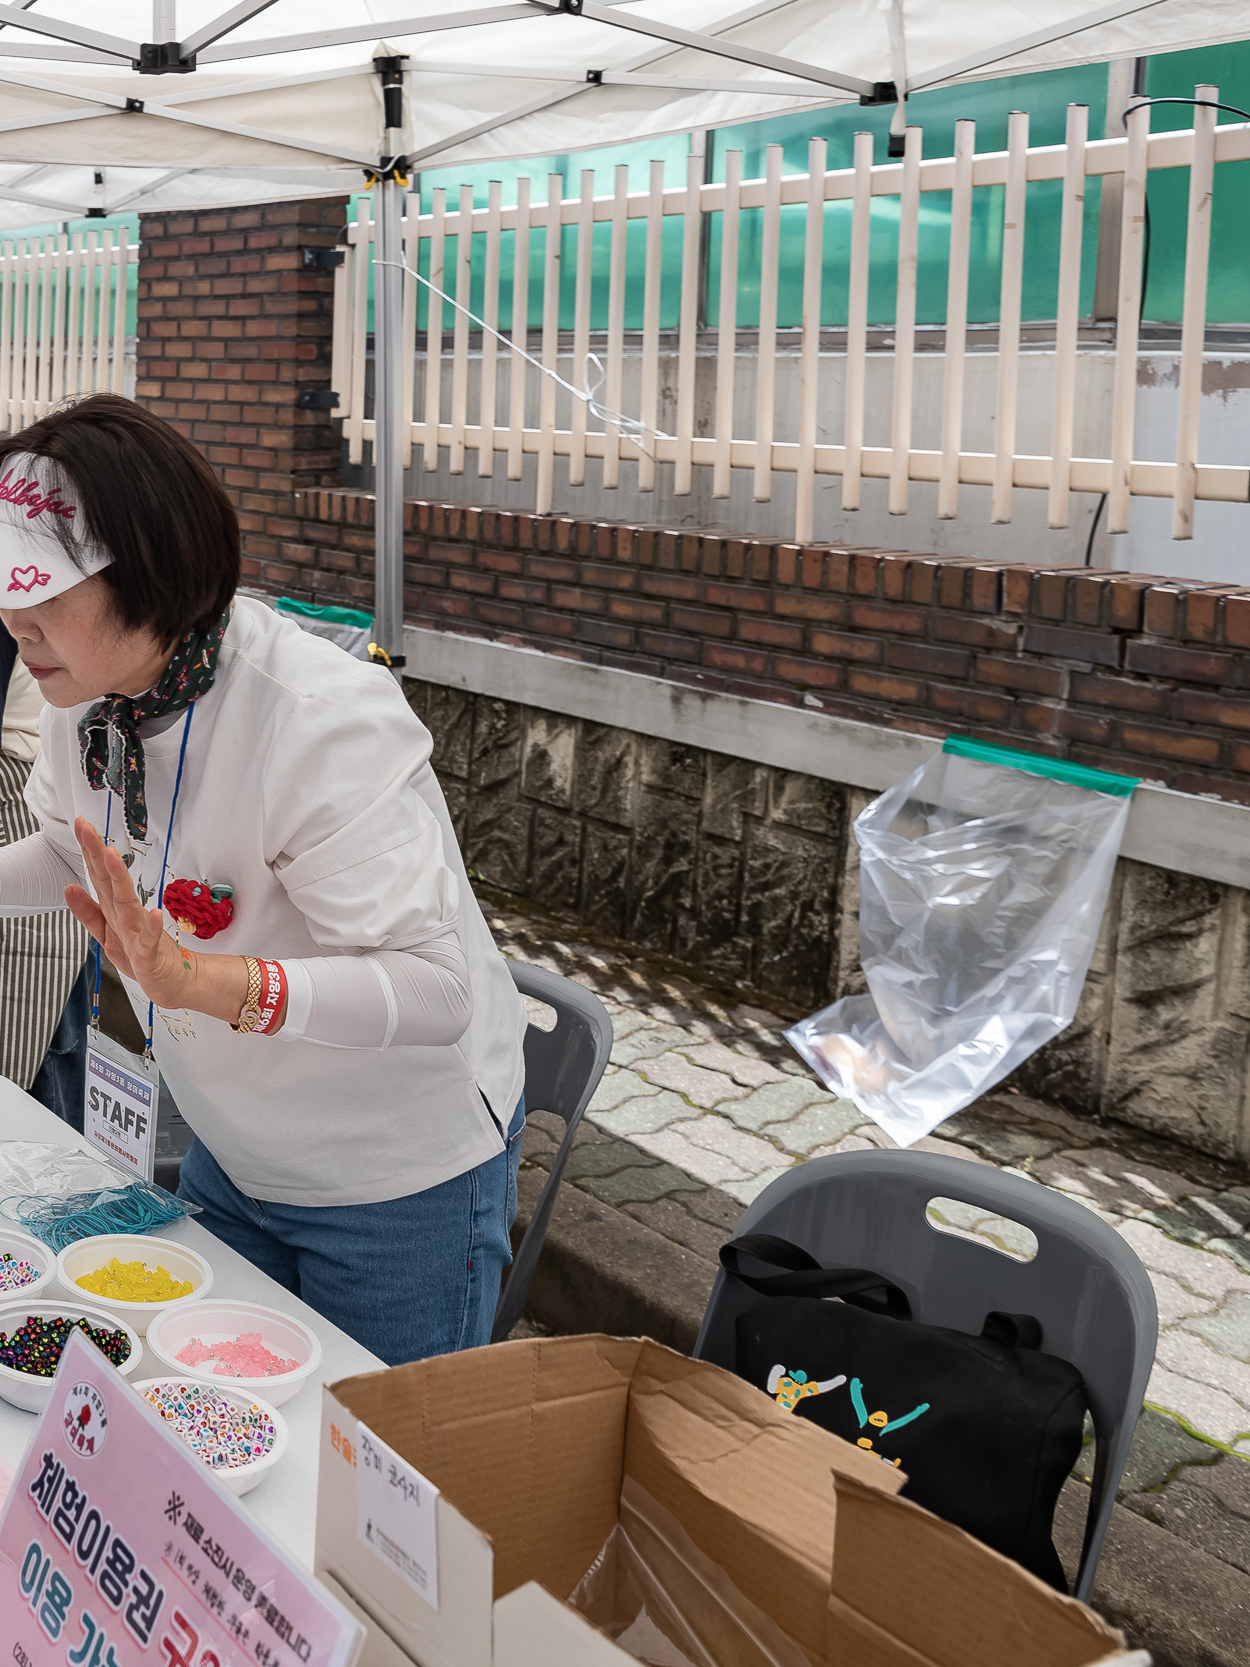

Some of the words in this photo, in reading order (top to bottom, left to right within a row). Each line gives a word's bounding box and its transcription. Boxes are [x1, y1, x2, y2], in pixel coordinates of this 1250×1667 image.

[252, 1007, 275, 1032] 제6회
[265, 963, 281, 1006] 자양3동
[88, 1085, 148, 1140] STAFF
[360, 1434, 383, 1475] 장미
[28, 1450, 165, 1646] 체험이용권
[19, 1541, 74, 1640] 이용
